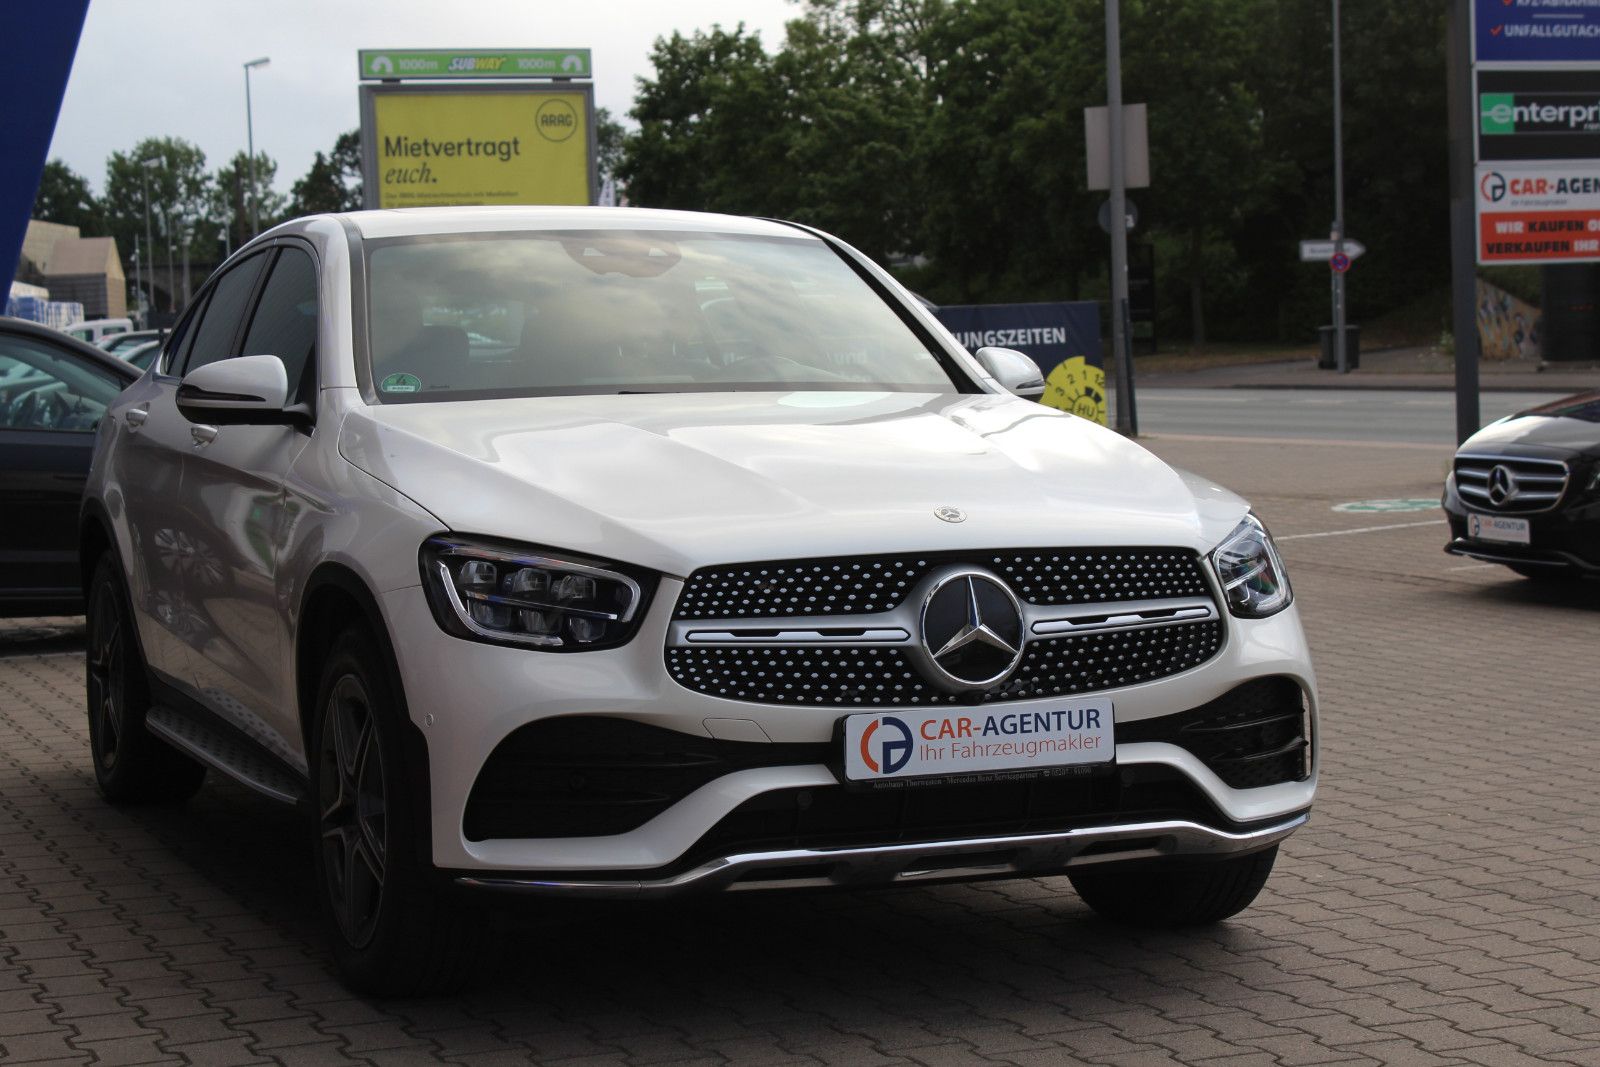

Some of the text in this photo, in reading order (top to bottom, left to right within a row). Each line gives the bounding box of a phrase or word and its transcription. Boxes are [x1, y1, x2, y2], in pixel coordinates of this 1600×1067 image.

[449, 56, 506, 71] SUBWAY
[540, 113, 573, 127] ARAG
[384, 136, 520, 161] Mietvertragt
[385, 163, 437, 184] euch.
[1495, 221, 1524, 234] WIR
[1528, 220, 1584, 233] KAUFEN
[1487, 241, 1570, 254] VERKAUFEN
[920, 708, 1101, 741] CAR-AGENTUR
[920, 733, 1101, 761] Ihr Fahrzeugmakler
